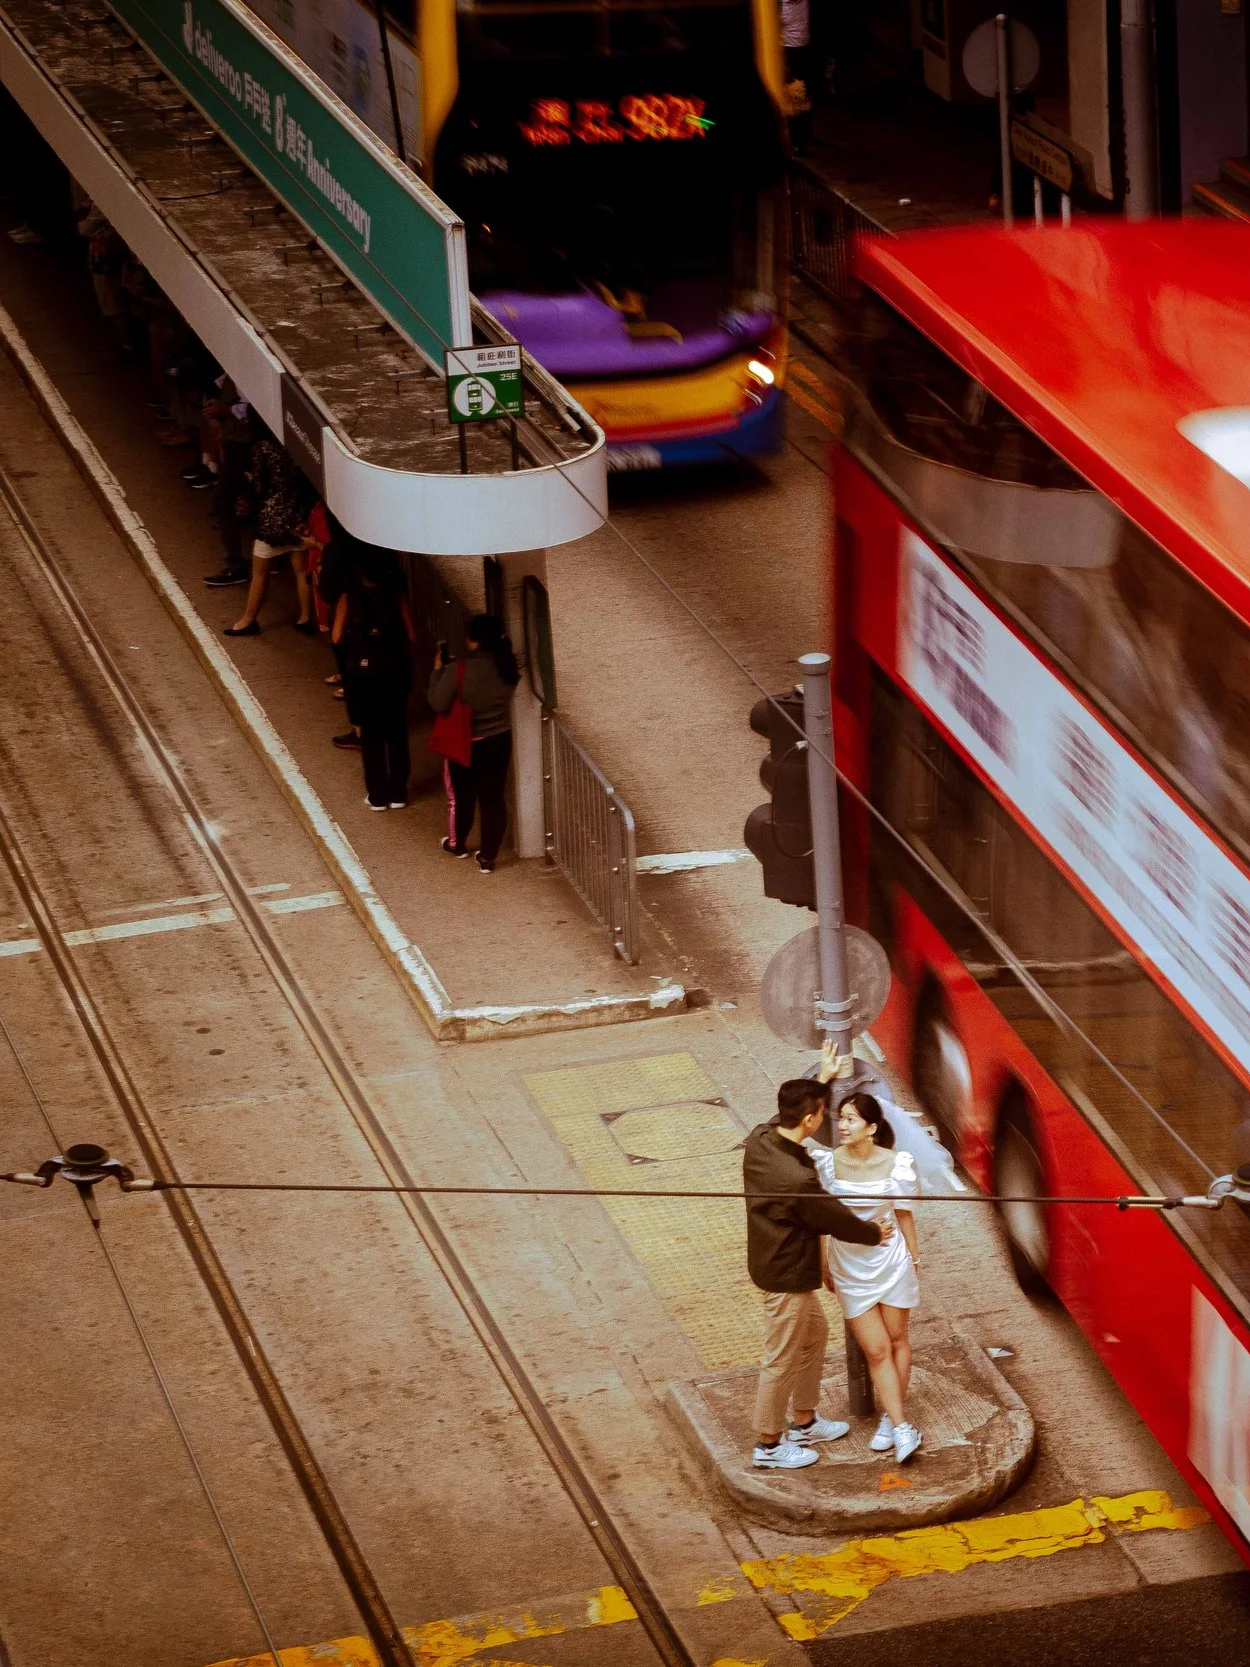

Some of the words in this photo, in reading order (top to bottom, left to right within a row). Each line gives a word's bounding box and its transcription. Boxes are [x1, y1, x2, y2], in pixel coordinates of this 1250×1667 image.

[195, 20, 242, 102] deliveroo
[307, 139, 371, 253] Anniversary
[500, 372, 518, 381] 25E
